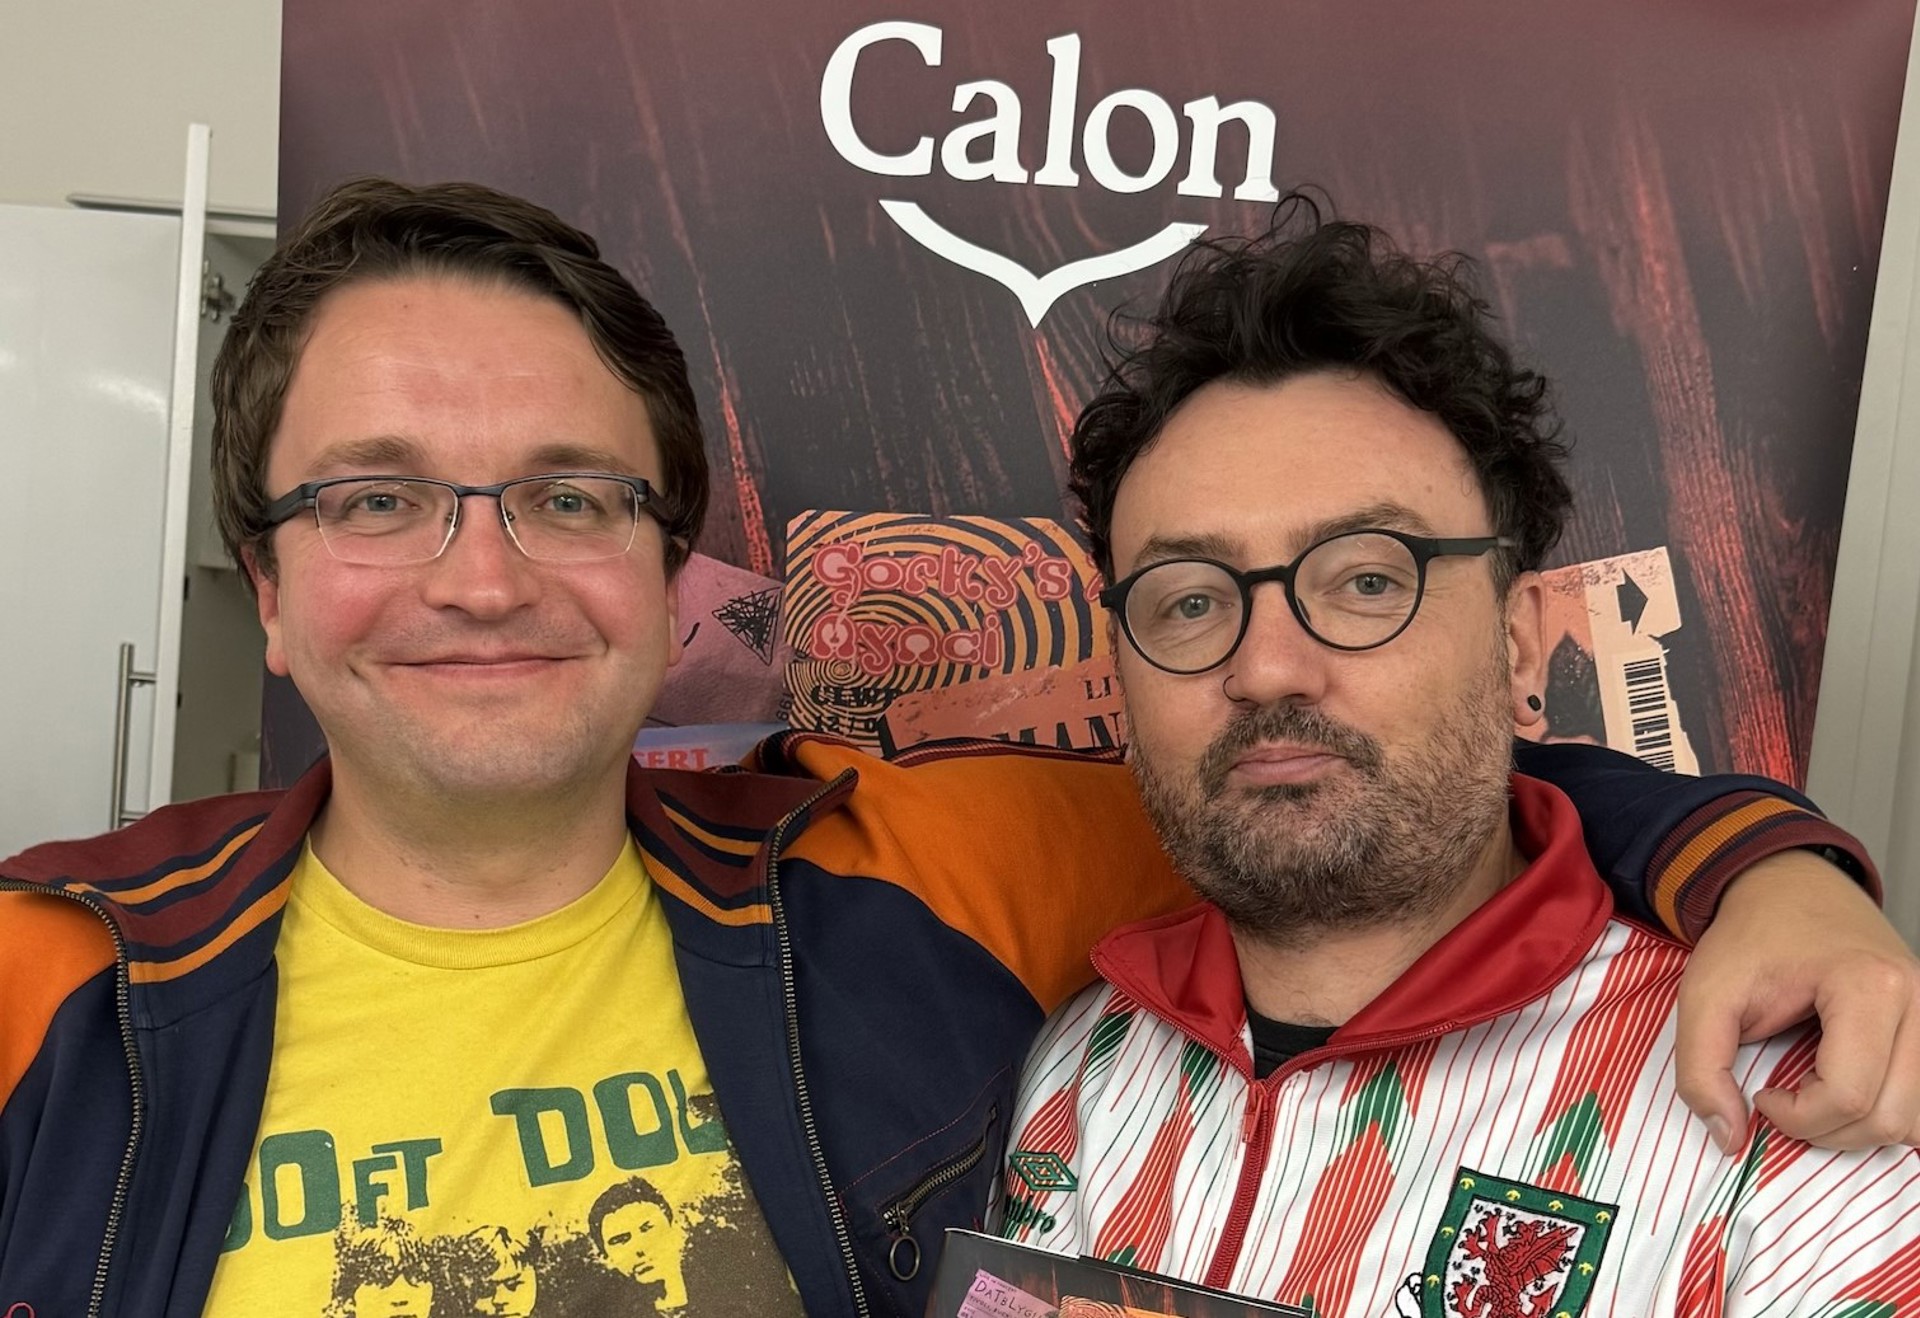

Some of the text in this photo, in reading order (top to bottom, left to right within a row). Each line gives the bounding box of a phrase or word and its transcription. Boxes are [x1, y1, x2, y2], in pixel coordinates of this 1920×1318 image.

[820, 21, 1279, 202] Calon
[811, 540, 1073, 610] Gorky's
[636, 748, 709, 772] ERT
